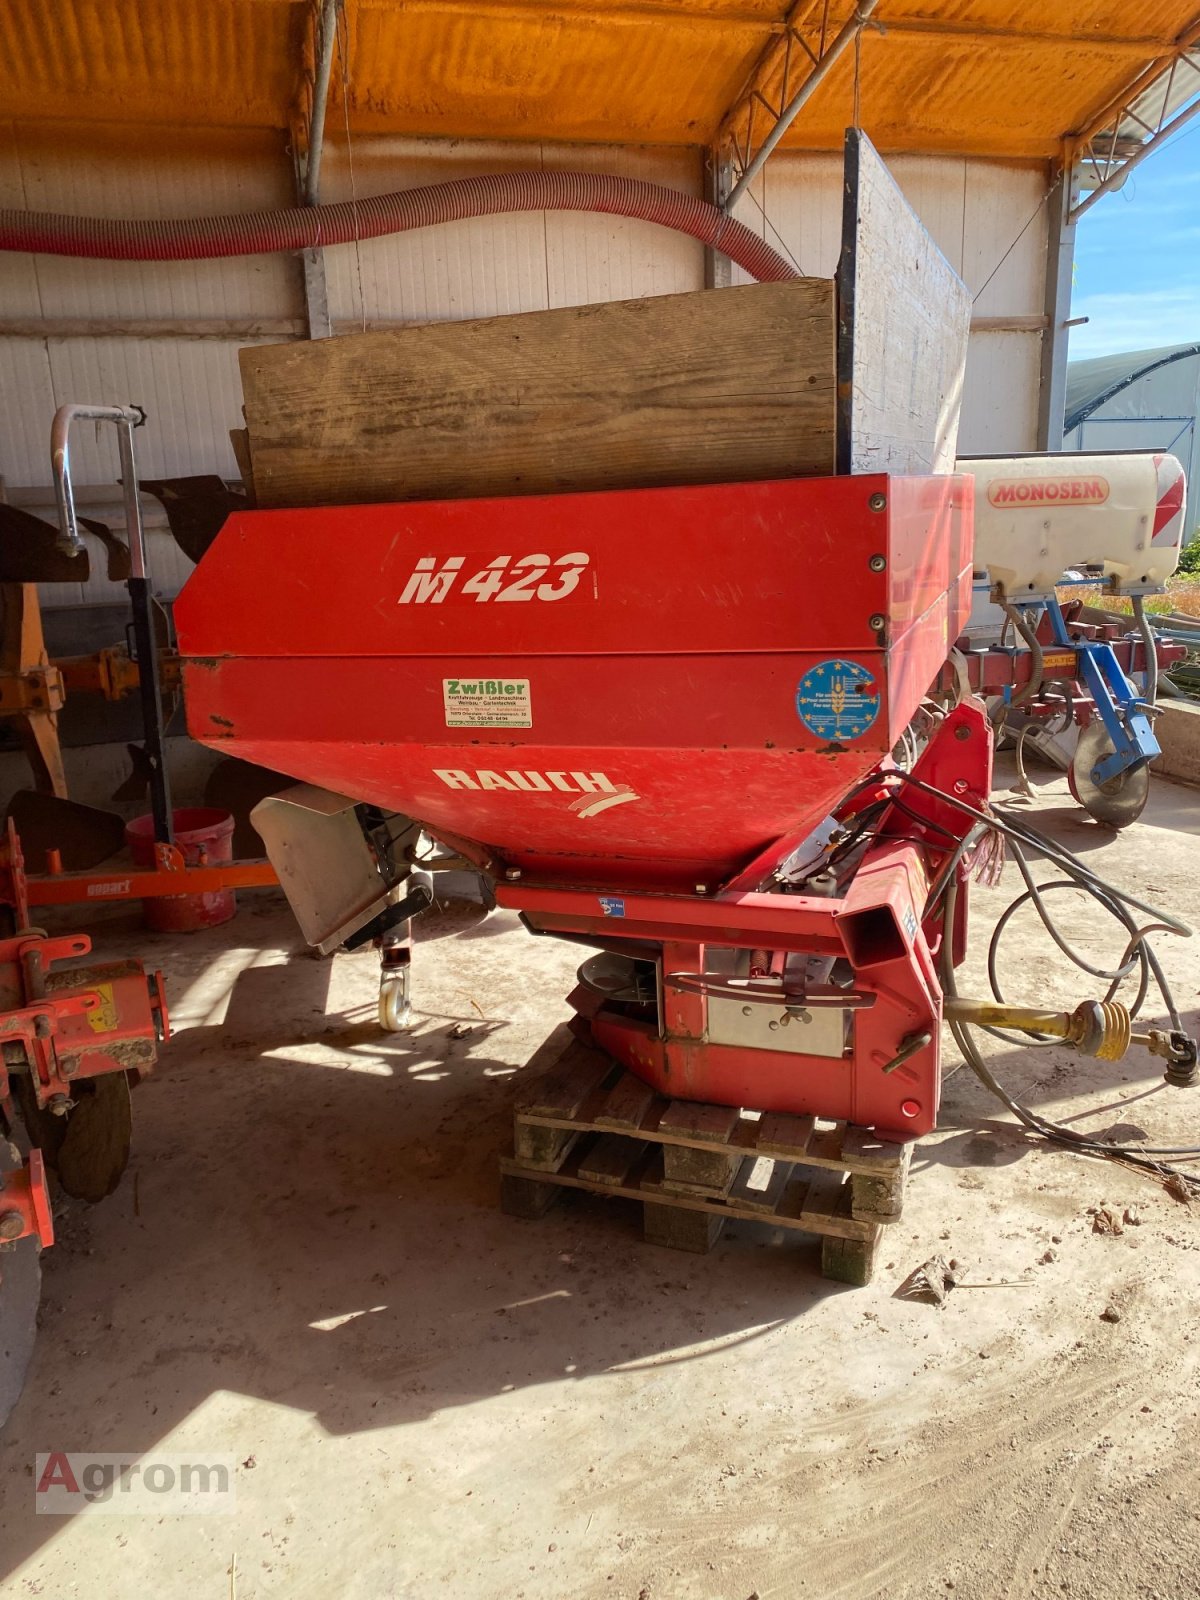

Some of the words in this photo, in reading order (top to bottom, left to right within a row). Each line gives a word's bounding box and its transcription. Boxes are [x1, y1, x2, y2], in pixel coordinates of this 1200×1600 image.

[993, 481, 1104, 502] MONOSEM
[397, 556, 466, 603] M
[461, 552, 590, 602] 423
[448, 681, 525, 695] Zwißler
[432, 769, 618, 793] RAUCH
